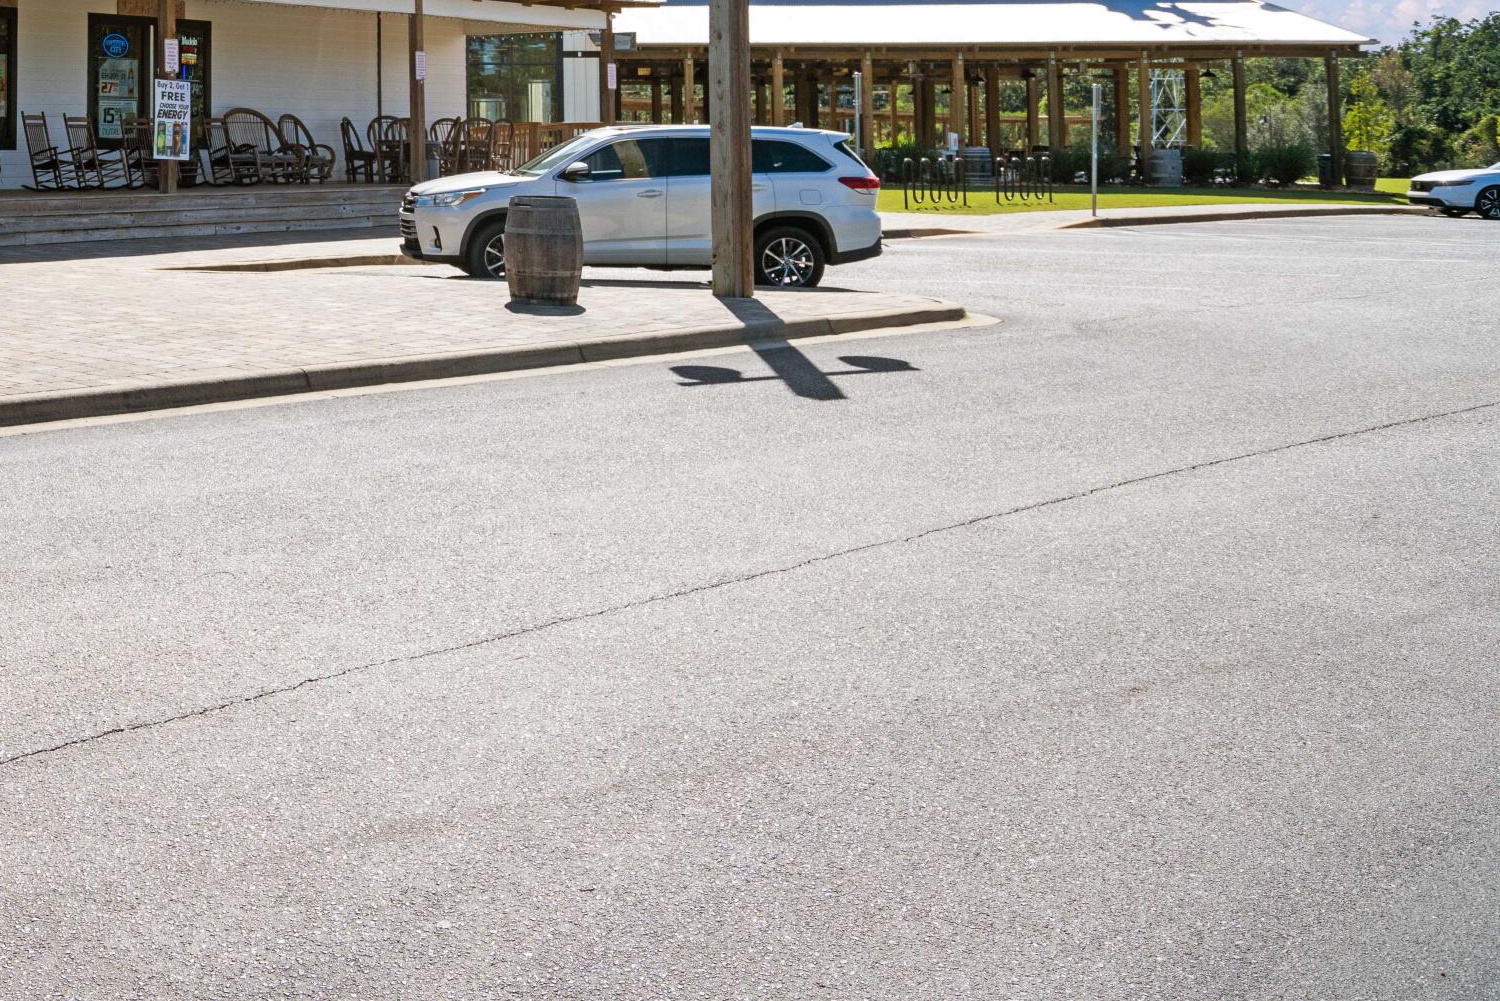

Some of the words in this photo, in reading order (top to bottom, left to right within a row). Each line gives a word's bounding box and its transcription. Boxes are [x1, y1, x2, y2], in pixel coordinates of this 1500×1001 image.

[157, 81, 168, 89] Buy
[161, 91, 186, 102] FREE
[103, 107, 115, 124] 15
[157, 109, 188, 120] ENERGY
